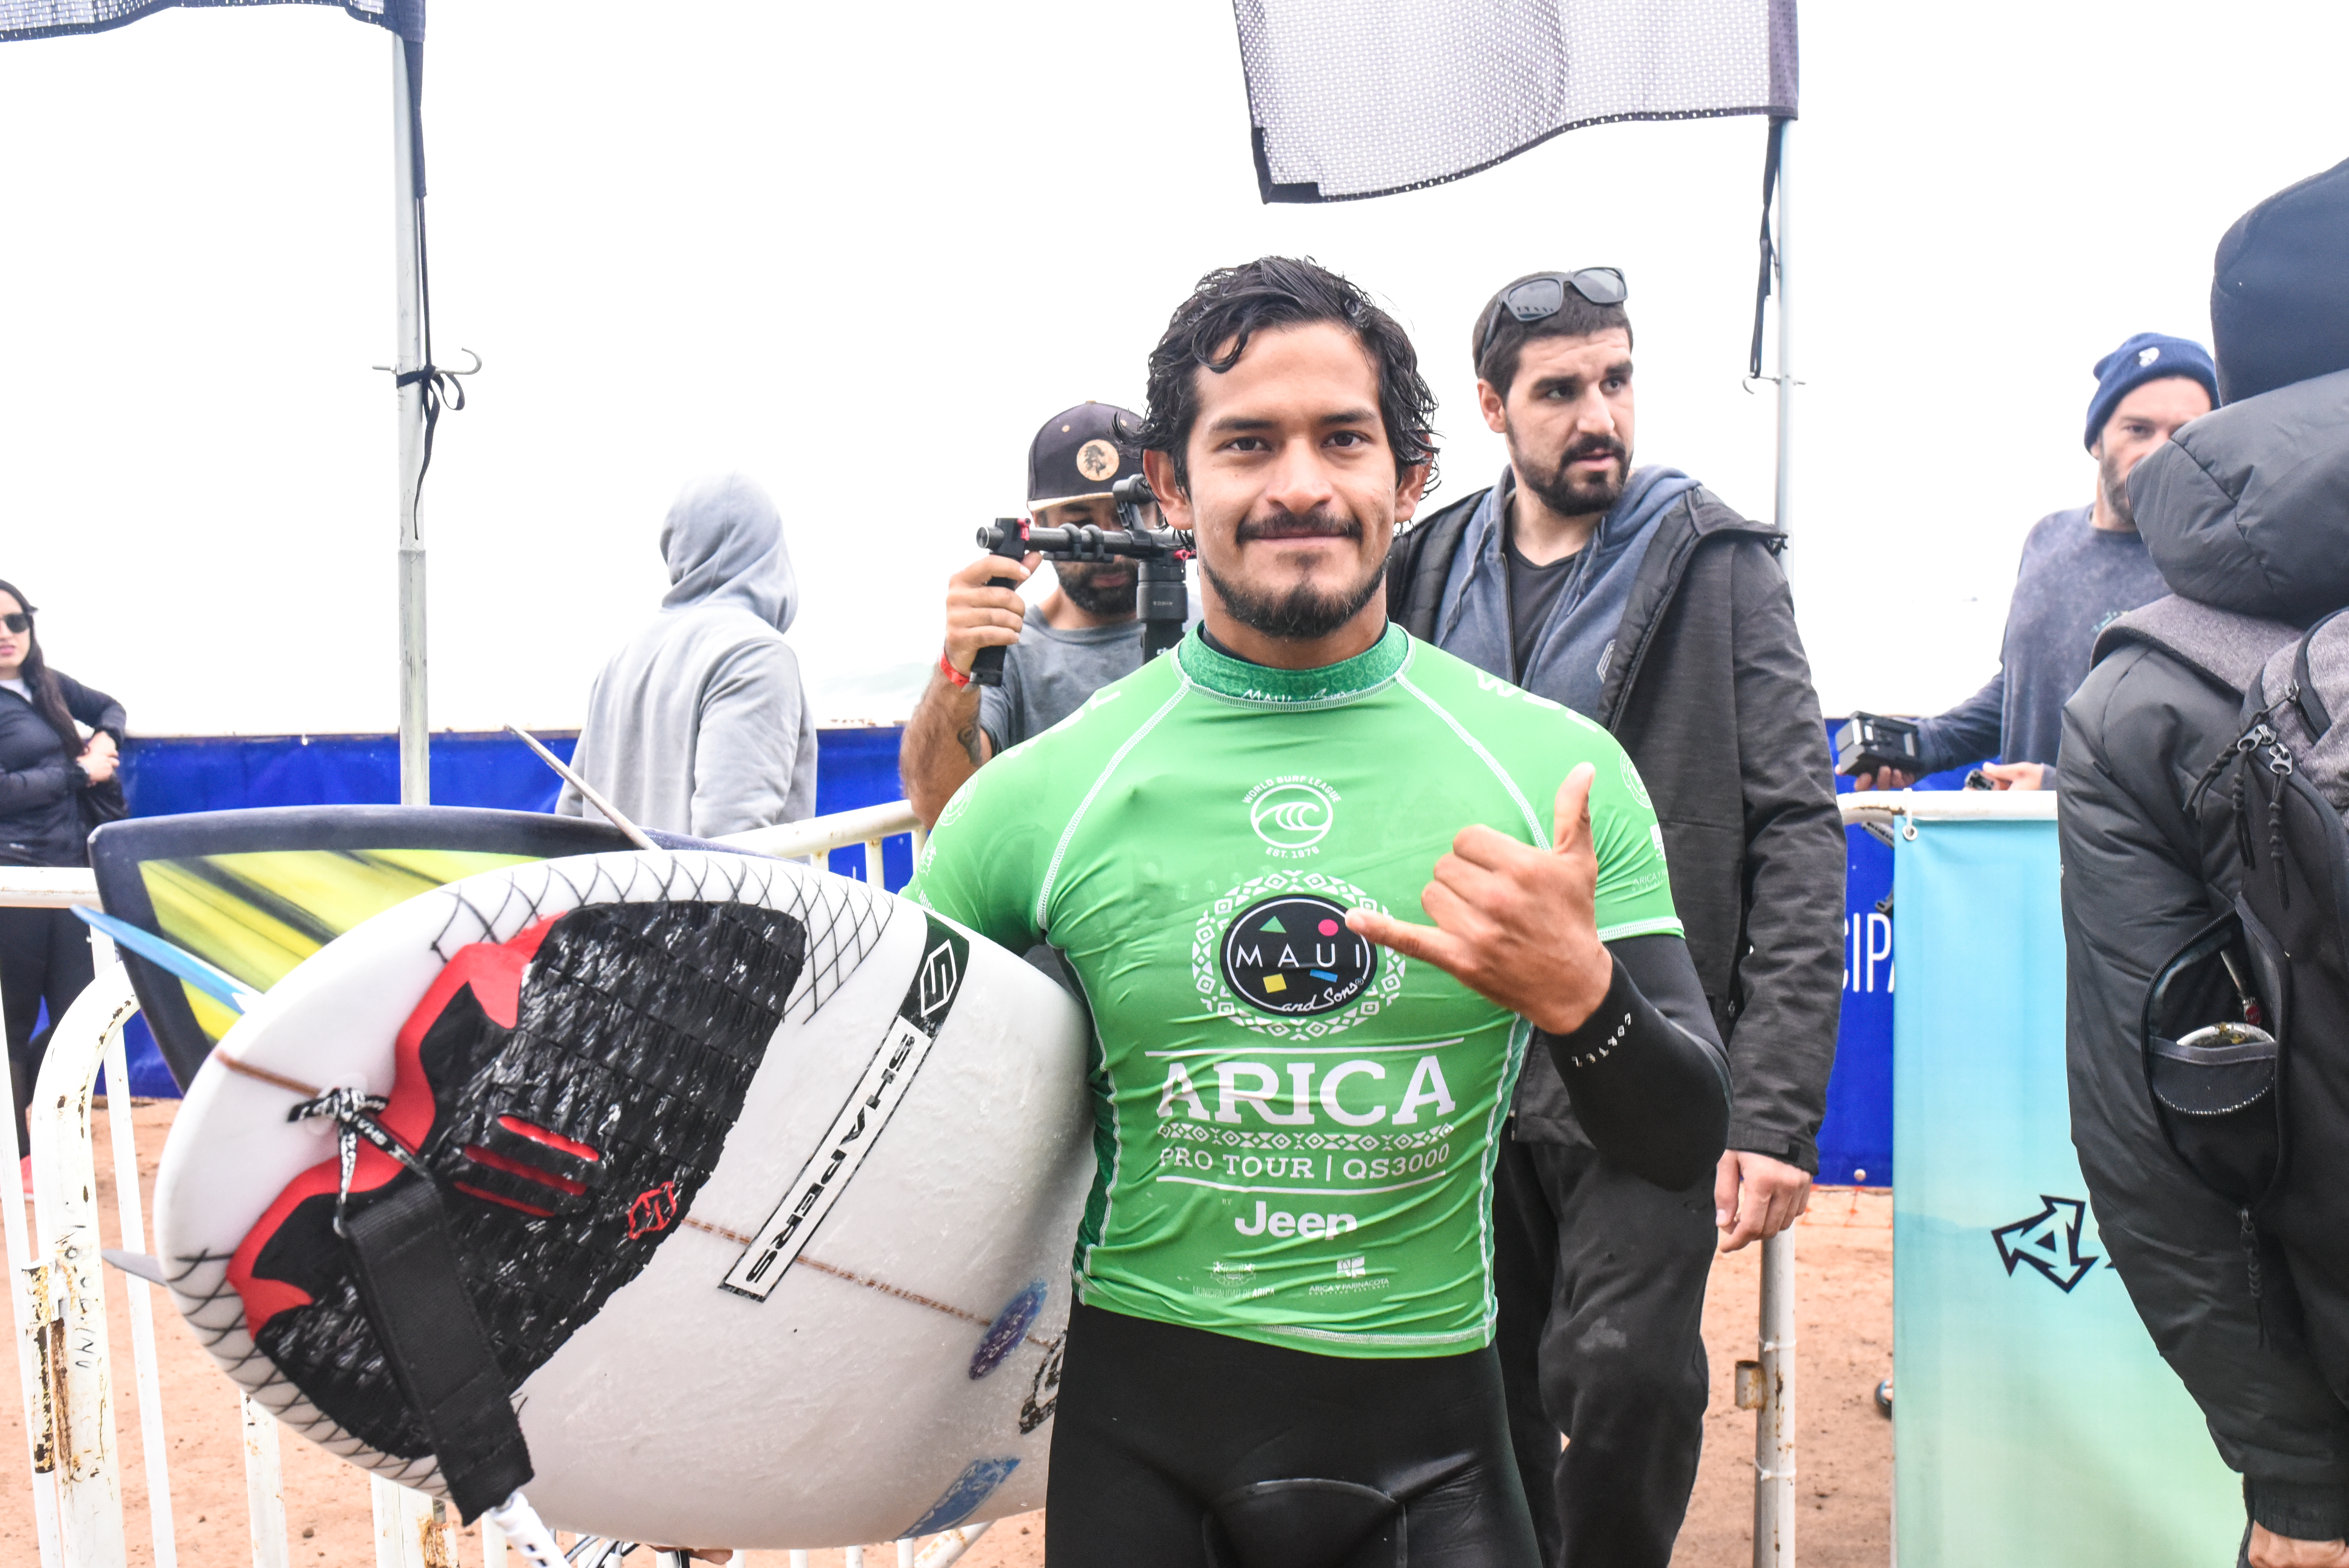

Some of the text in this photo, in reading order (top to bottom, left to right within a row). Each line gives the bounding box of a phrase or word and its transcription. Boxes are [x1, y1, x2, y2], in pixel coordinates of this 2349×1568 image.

[1242, 775, 1341, 804] WORLD SURF LEAGUE
[1265, 847, 1288, 858] EST.
[1236, 943, 1360, 968] MAUI
[1843, 912, 1894, 993] IP
[1281, 994, 1317, 1012] and
[1157, 1055, 1456, 1126] ARICA
[745, 1033, 915, 1283] SHAPERS
[1159, 1142, 1449, 1180] PRO TOUR QS3000
[1235, 1201, 1358, 1240] Jeep
[1252, 1287, 1274, 1298] ARICA
